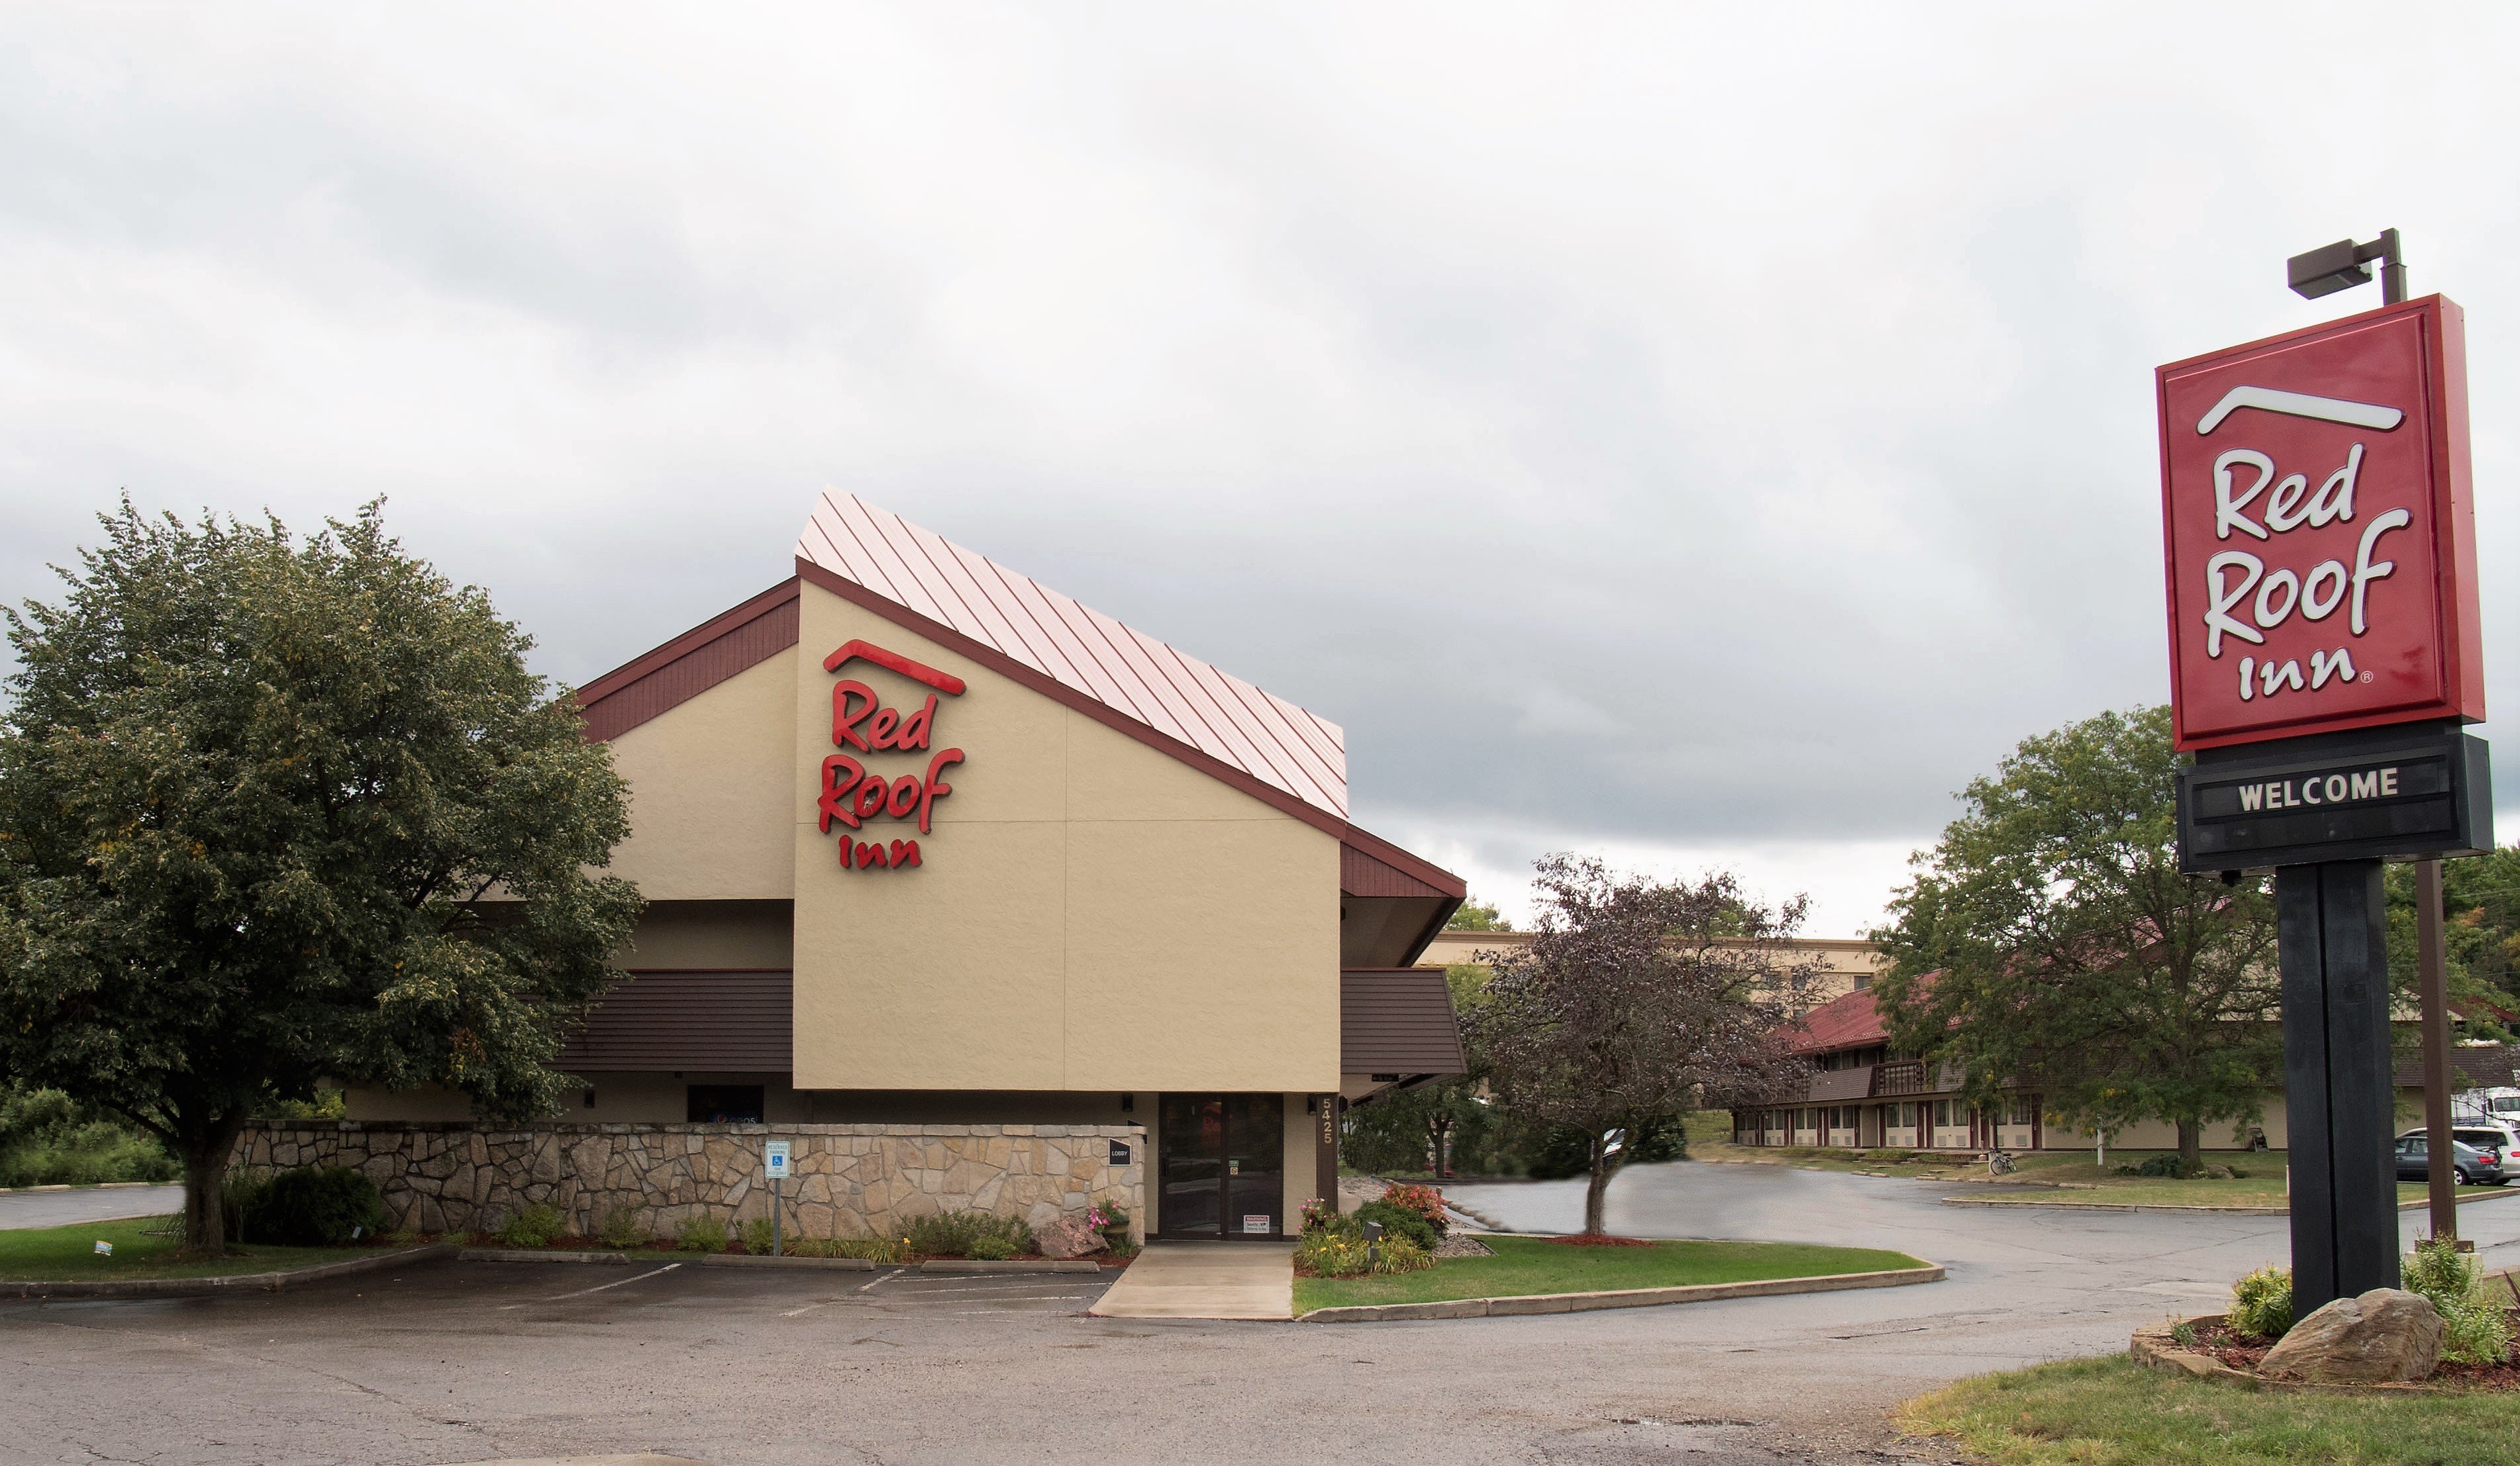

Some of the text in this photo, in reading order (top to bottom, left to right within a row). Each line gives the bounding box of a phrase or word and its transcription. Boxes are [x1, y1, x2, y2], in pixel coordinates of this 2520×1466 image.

[2213, 442, 2366, 541] Red
[2203, 508, 2413, 658] Roof
[2239, 646, 2358, 702] Inn
[832, 679, 938, 754] Red
[817, 748, 965, 834] Roof
[2239, 767, 2398, 811] WELCOME
[838, 834, 923, 869] Inn
[1322, 1099, 1332, 1144] 5425
